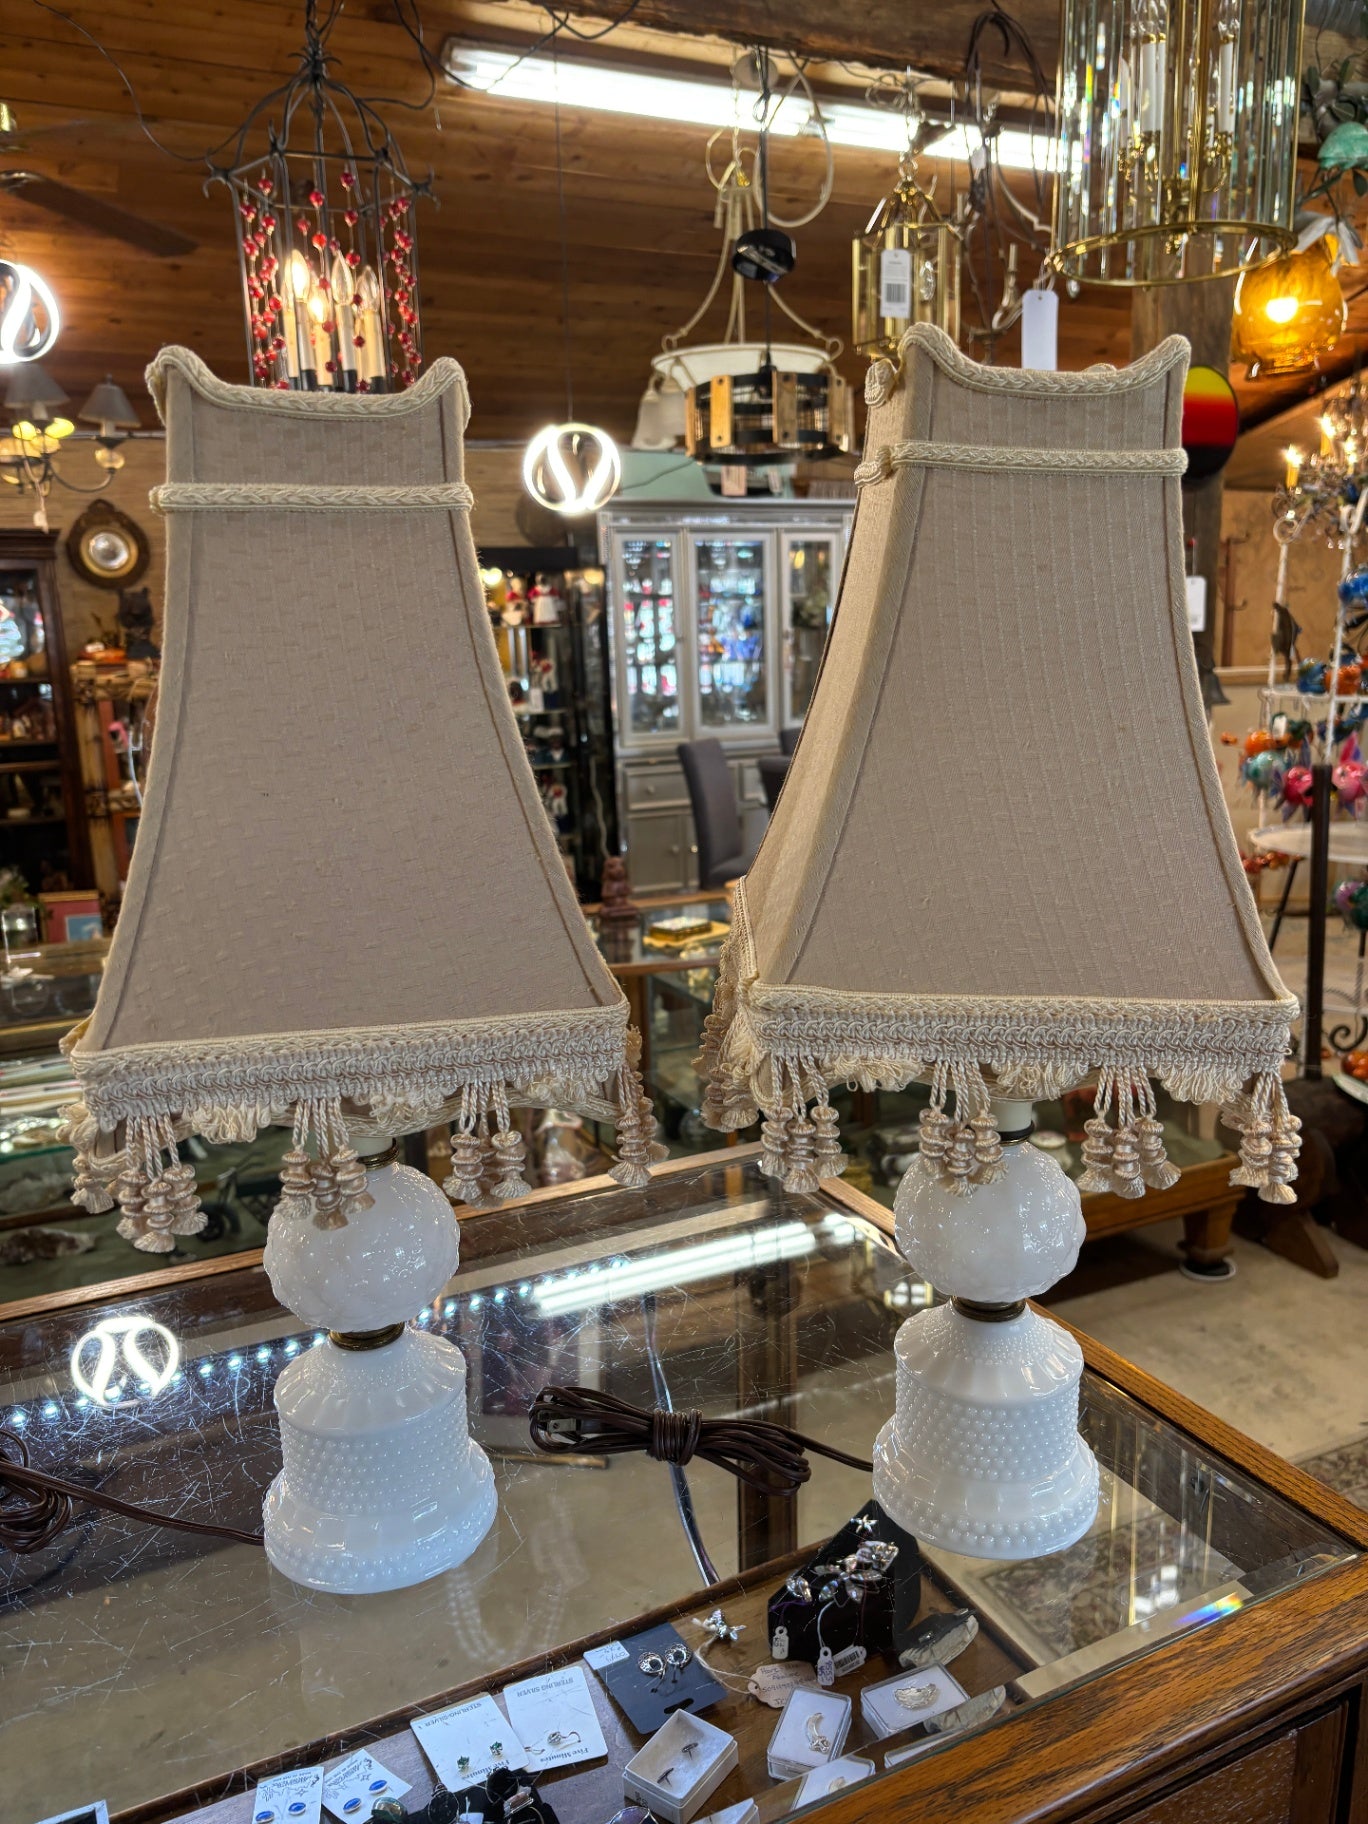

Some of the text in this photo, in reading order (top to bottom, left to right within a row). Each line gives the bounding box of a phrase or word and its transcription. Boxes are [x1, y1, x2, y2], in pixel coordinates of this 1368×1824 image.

[516, 1677, 574, 1698] STERLING SILVER
[540, 1747, 589, 1763] Five Minutes
